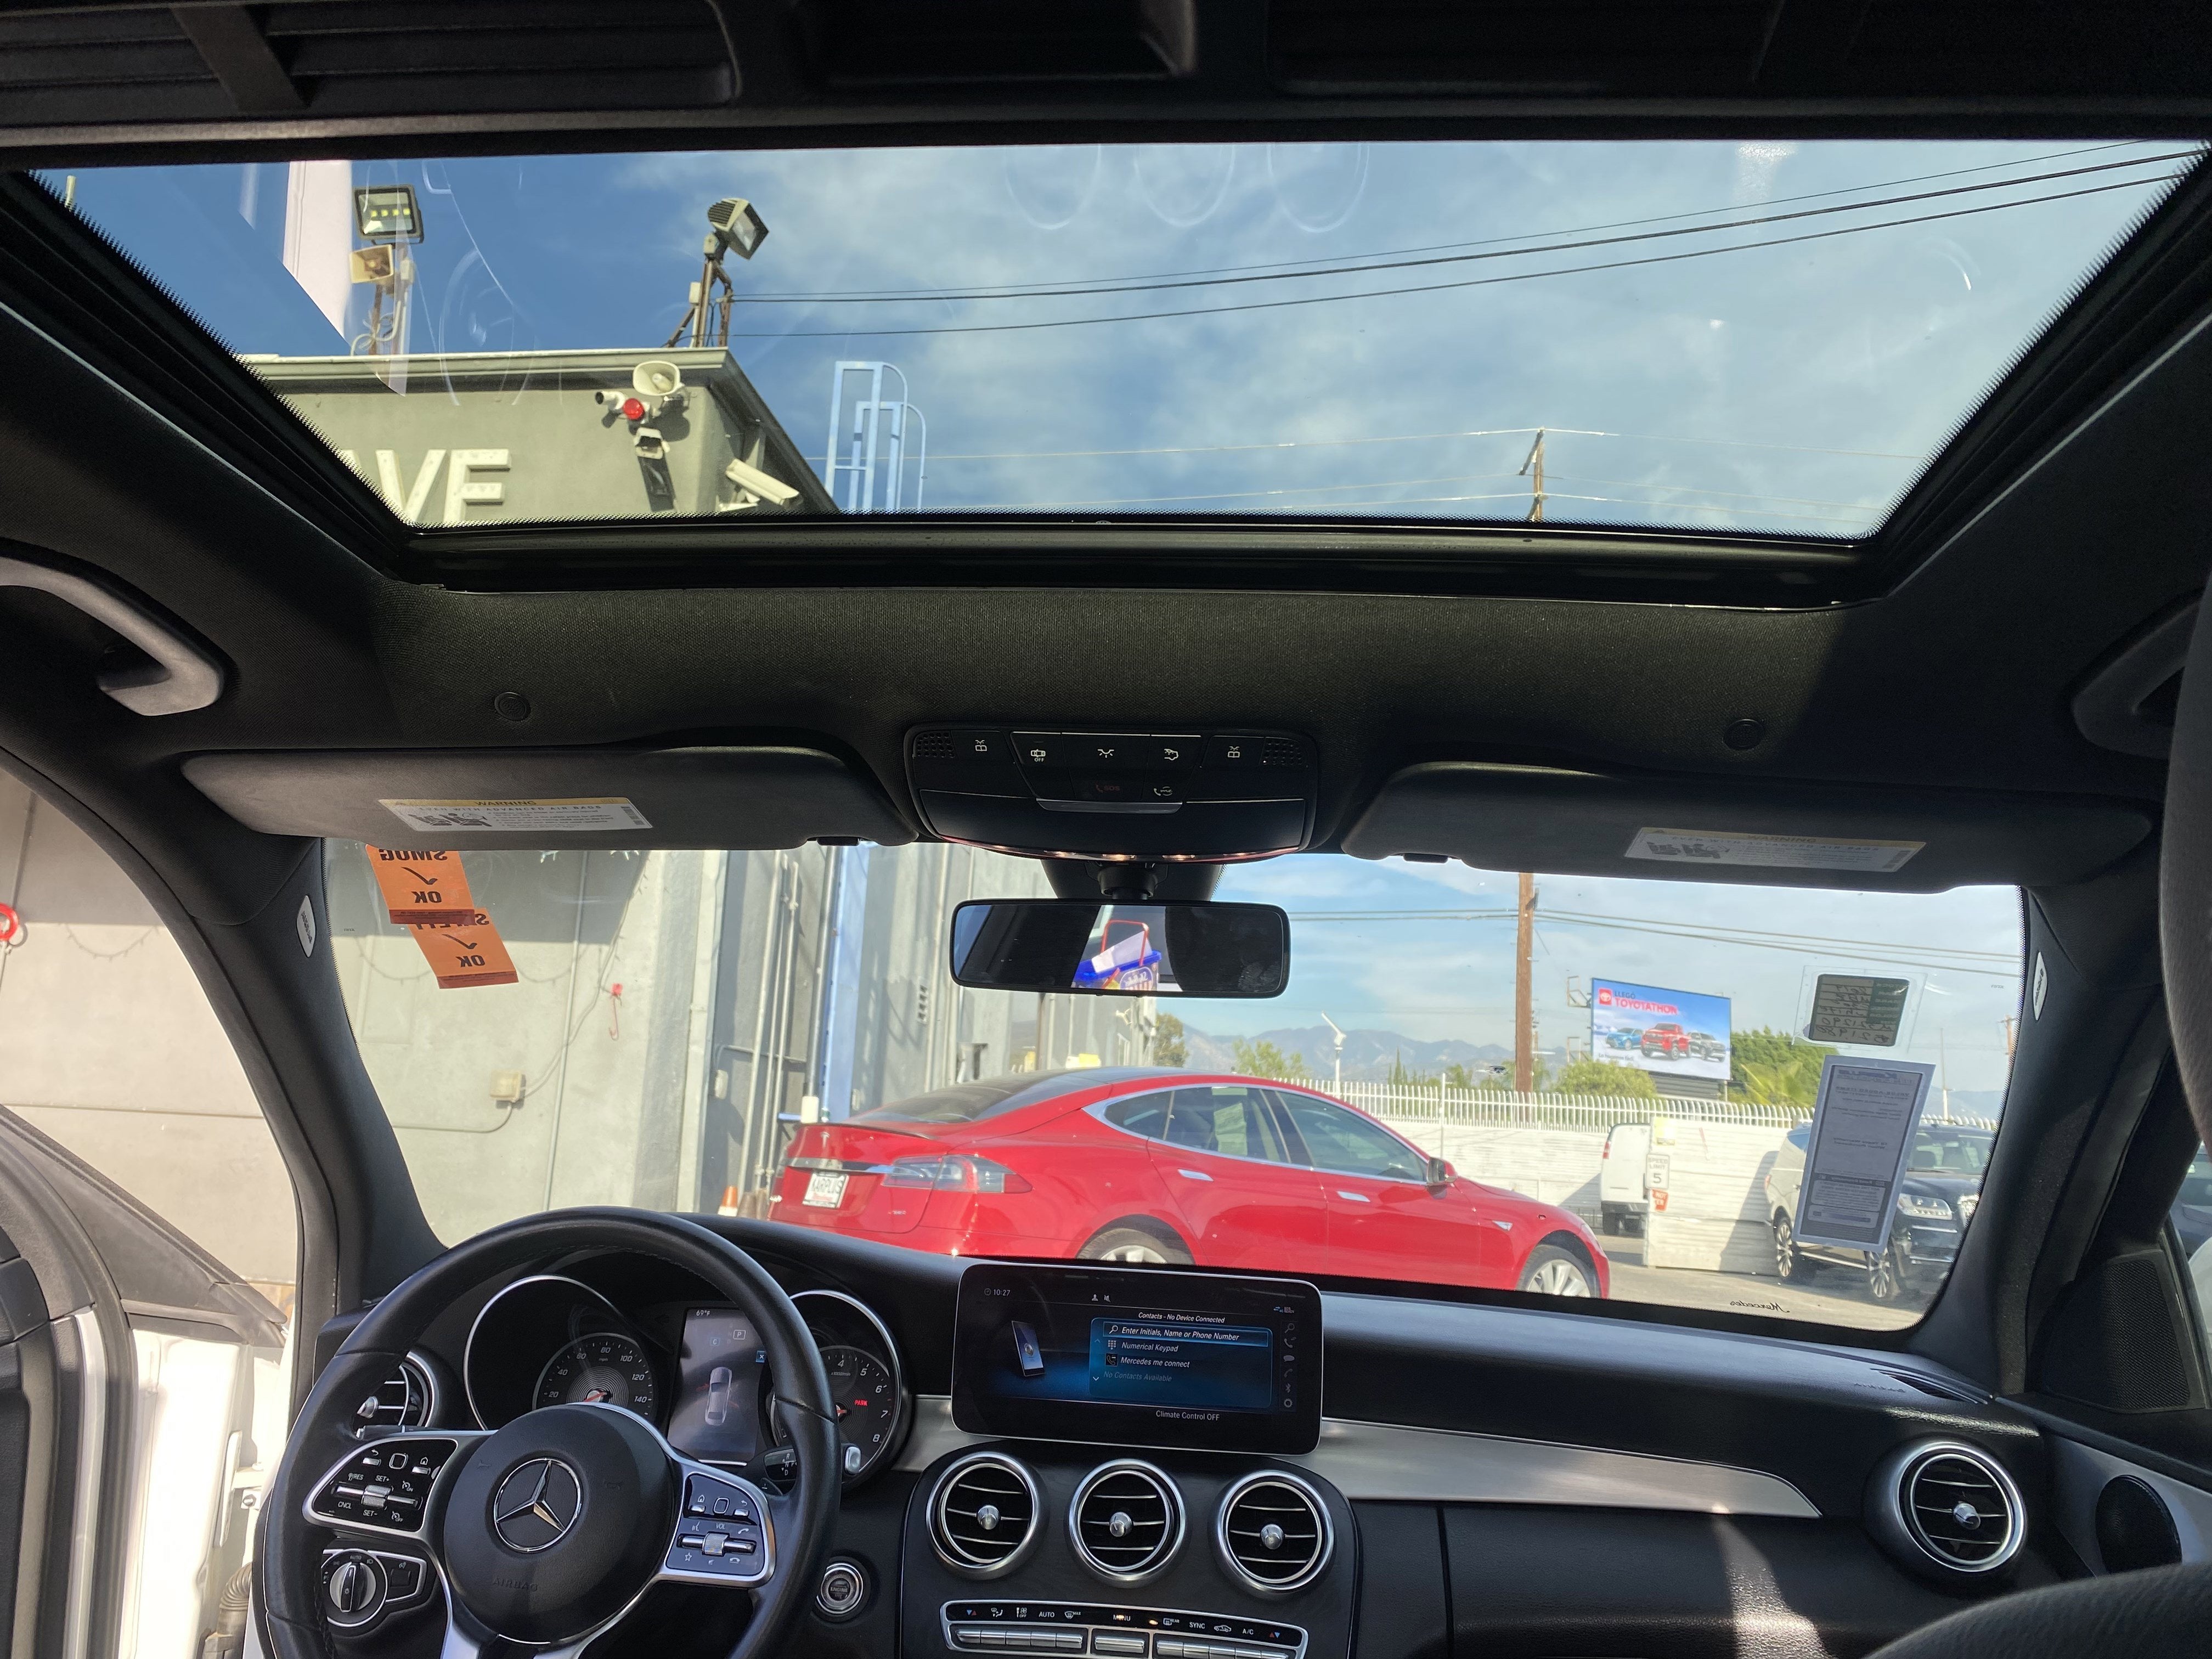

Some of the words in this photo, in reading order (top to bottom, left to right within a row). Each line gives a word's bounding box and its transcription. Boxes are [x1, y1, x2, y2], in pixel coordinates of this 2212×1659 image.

[1747, 834, 1817, 843] WARNING
[1615, 990, 1636, 999] LLEGÓ
[1615, 997, 1678, 1015] TOYOTATHON
[1653, 1173, 1662, 1183] 5
[1138, 1312, 1163, 1320] Contacts
[1121, 1327, 1139, 1335] Enter
[1139, 1328, 1162, 1337] Initials,
[1164, 1329, 1183, 1338] Name
[1192, 1331, 1212, 1339] Phone
[1213, 1333, 1239, 1341] Number
[1121, 1342, 1154, 1351] Numerical
[1155, 1344, 1179, 1353] Keypad
[1120, 1357, 1152, 1365] Mercedes
[1114, 1372, 1142, 1380] Contacts
[881, 1410, 888, 1418] 7
[1155, 1410, 1181, 1419] Climate
[1182, 1412, 1205, 1420] Control
[872, 1434, 880, 1442] 8
[337, 1501, 352, 1509] CNCL
[493, 1577, 538, 1592] AIRBAG
